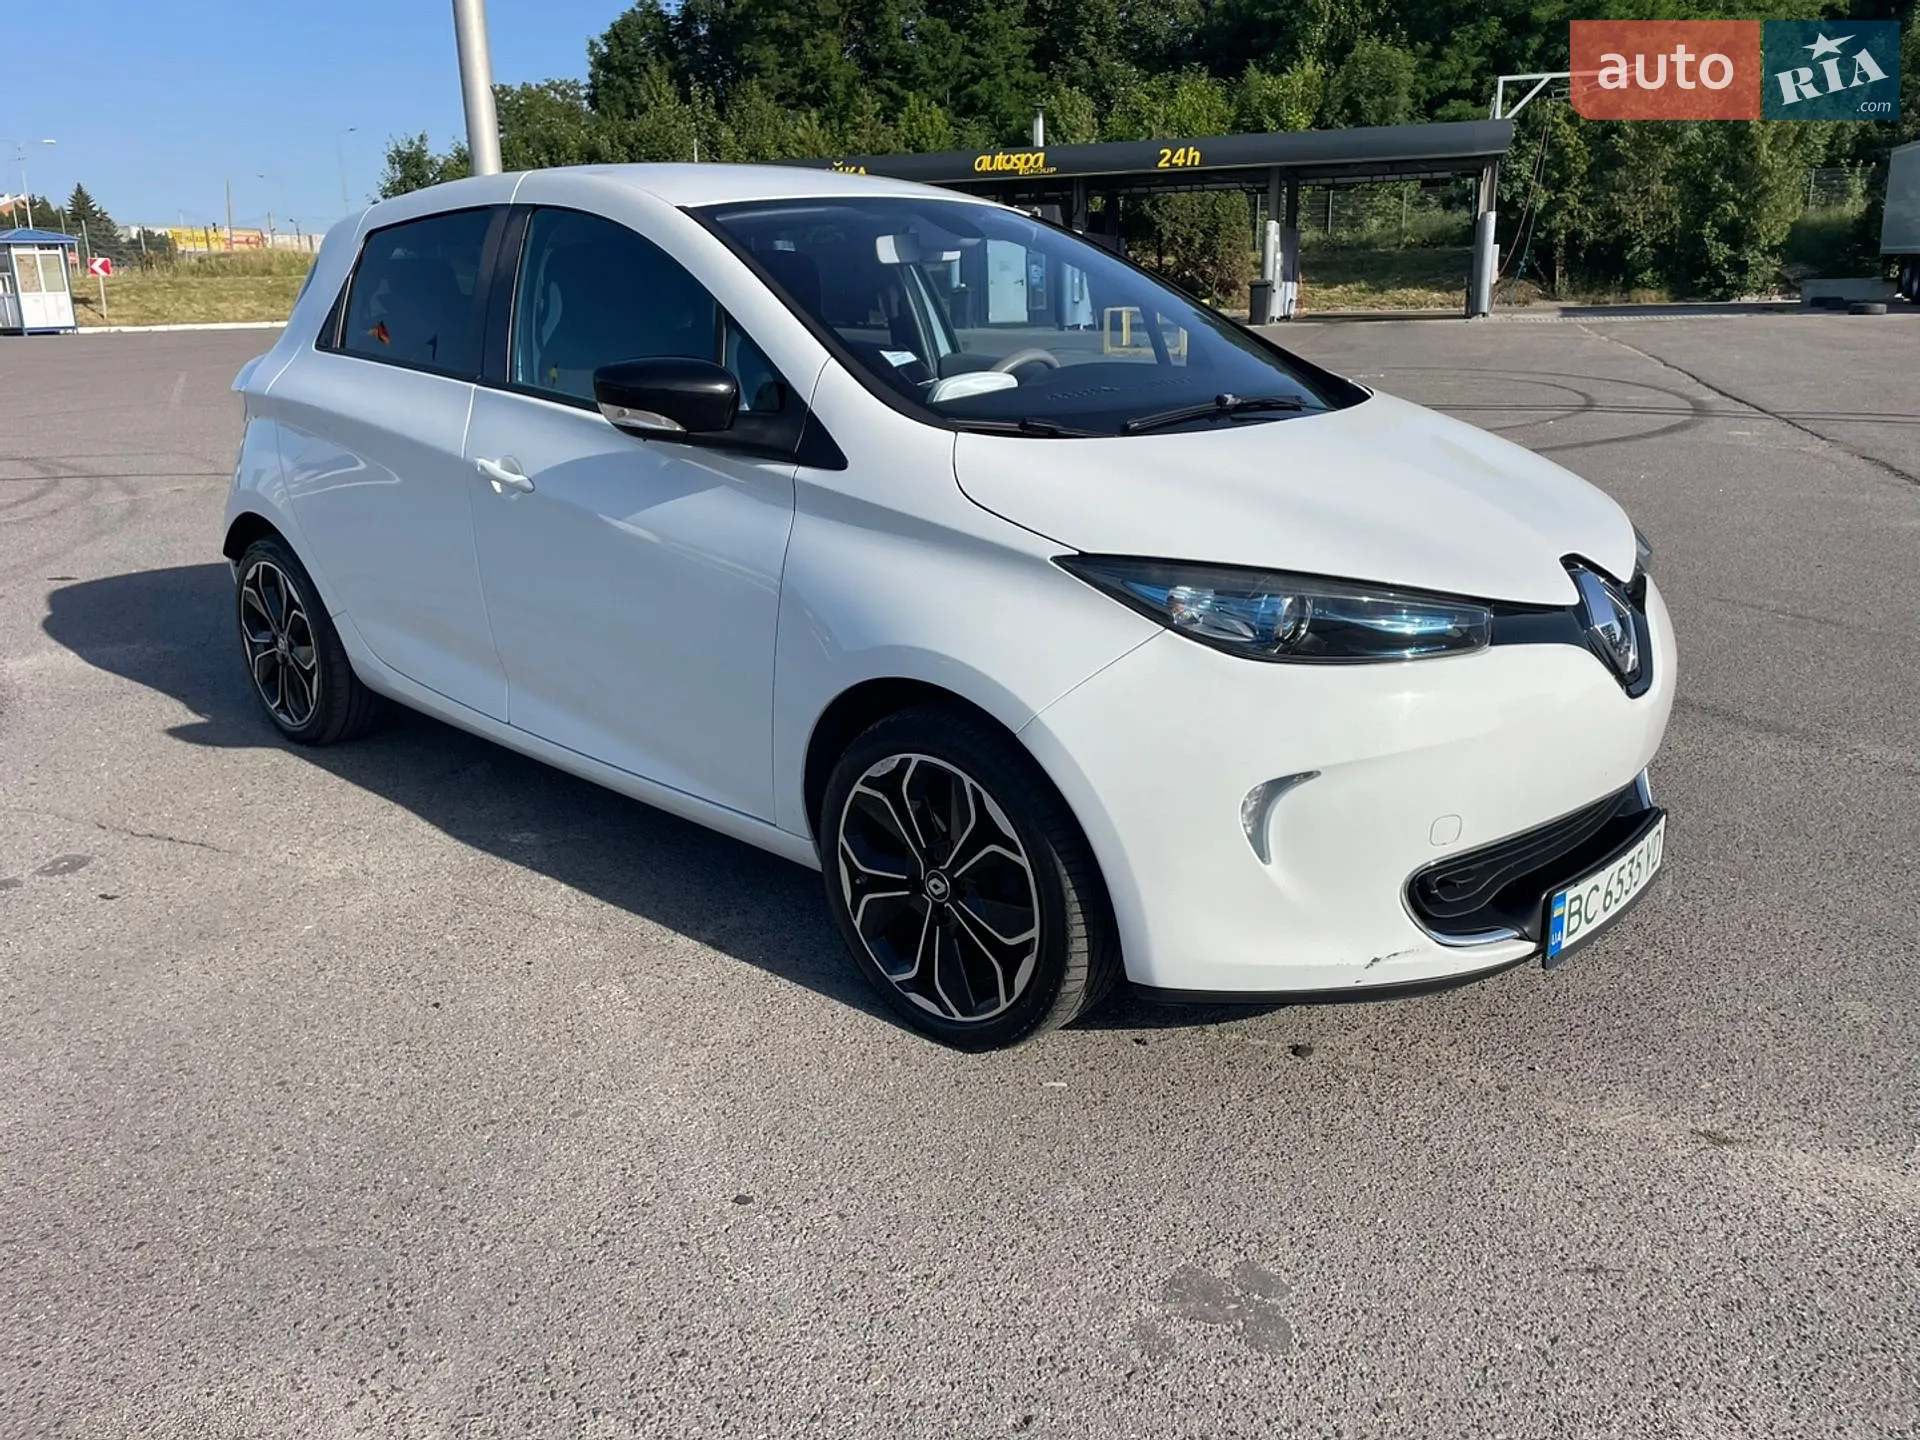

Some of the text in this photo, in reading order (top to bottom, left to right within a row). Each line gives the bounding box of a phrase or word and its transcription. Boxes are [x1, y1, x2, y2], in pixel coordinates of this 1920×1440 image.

[974, 151, 1045, 175] autospa
[1157, 146, 1201, 168] 24h
[1602, 848, 1644, 913] 6535
